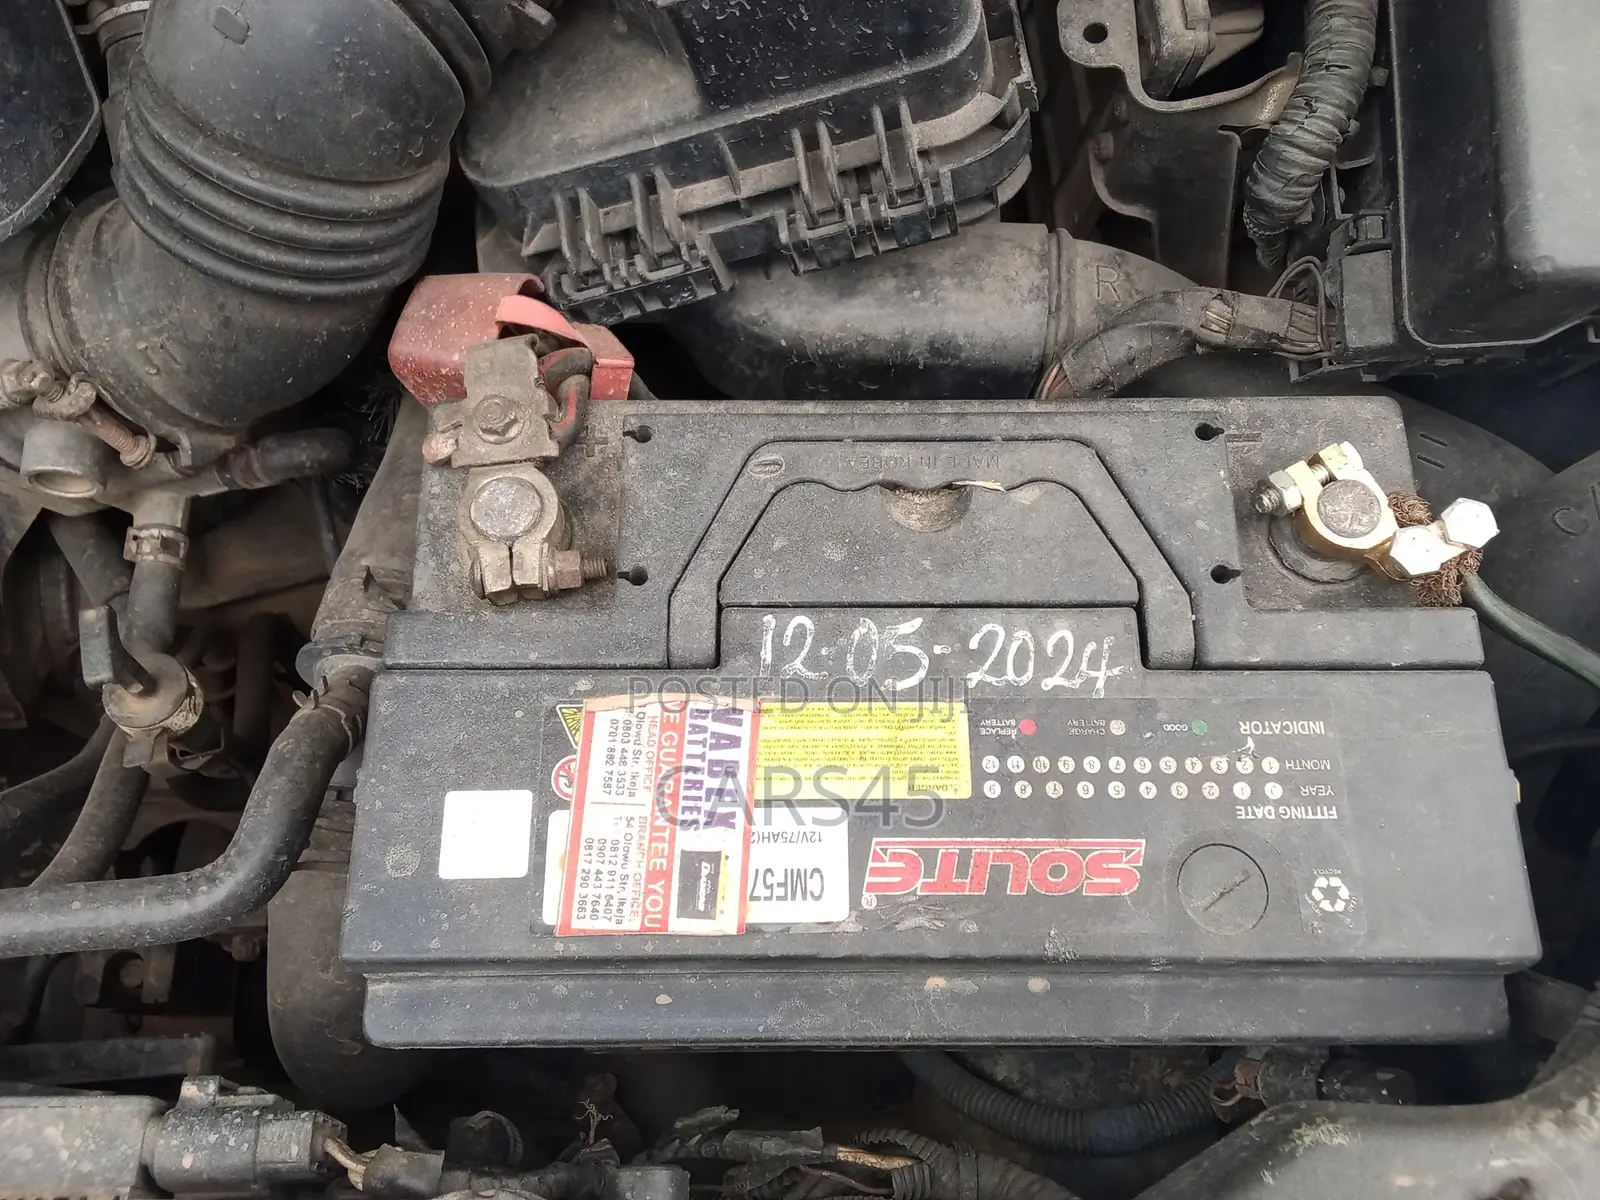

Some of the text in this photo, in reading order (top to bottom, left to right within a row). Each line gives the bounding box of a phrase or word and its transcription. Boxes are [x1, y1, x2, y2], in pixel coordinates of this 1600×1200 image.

[1096, 264, 1121, 300] R
[846, 455, 1000, 470] MADE IN KOREA
[620, 719, 632, 745] 0803
[980, 718, 1016, 726] BATTERY
[980, 727, 1018, 735] REPLACE
[1067, 718, 1106, 726] BATTERY
[1068, 727, 1106, 735] CHARGE
[1163, 723, 1189, 732] GOOD
[1239, 720, 1325, 736] INDICATOR
[643, 715, 659, 793] HEAD OFFICE
[1285, 759, 1331, 771] MONTH
[679, 707, 710, 831] BATTERIES
[615, 770, 627, 797] 3533
[628, 771, 640, 798] Ikeja
[908, 784, 949, 792] DANGER
[1300, 785, 1336, 797] YEAR
[649, 730, 679, 872] GUARANTEE
[1235, 805, 1338, 820] FITTING DATE
[607, 839, 620, 867] 0812
[620, 832, 634, 870] Olowu
[635, 815, 648, 869] BRANCH
[576, 837, 595, 920] 0817 290 3663
[589, 838, 607, 921] 0907 443 7640
[863, 842, 1145, 896] SOLITE
[614, 897, 628, 925] Ikeja
[644, 880, 665, 928] YOU
